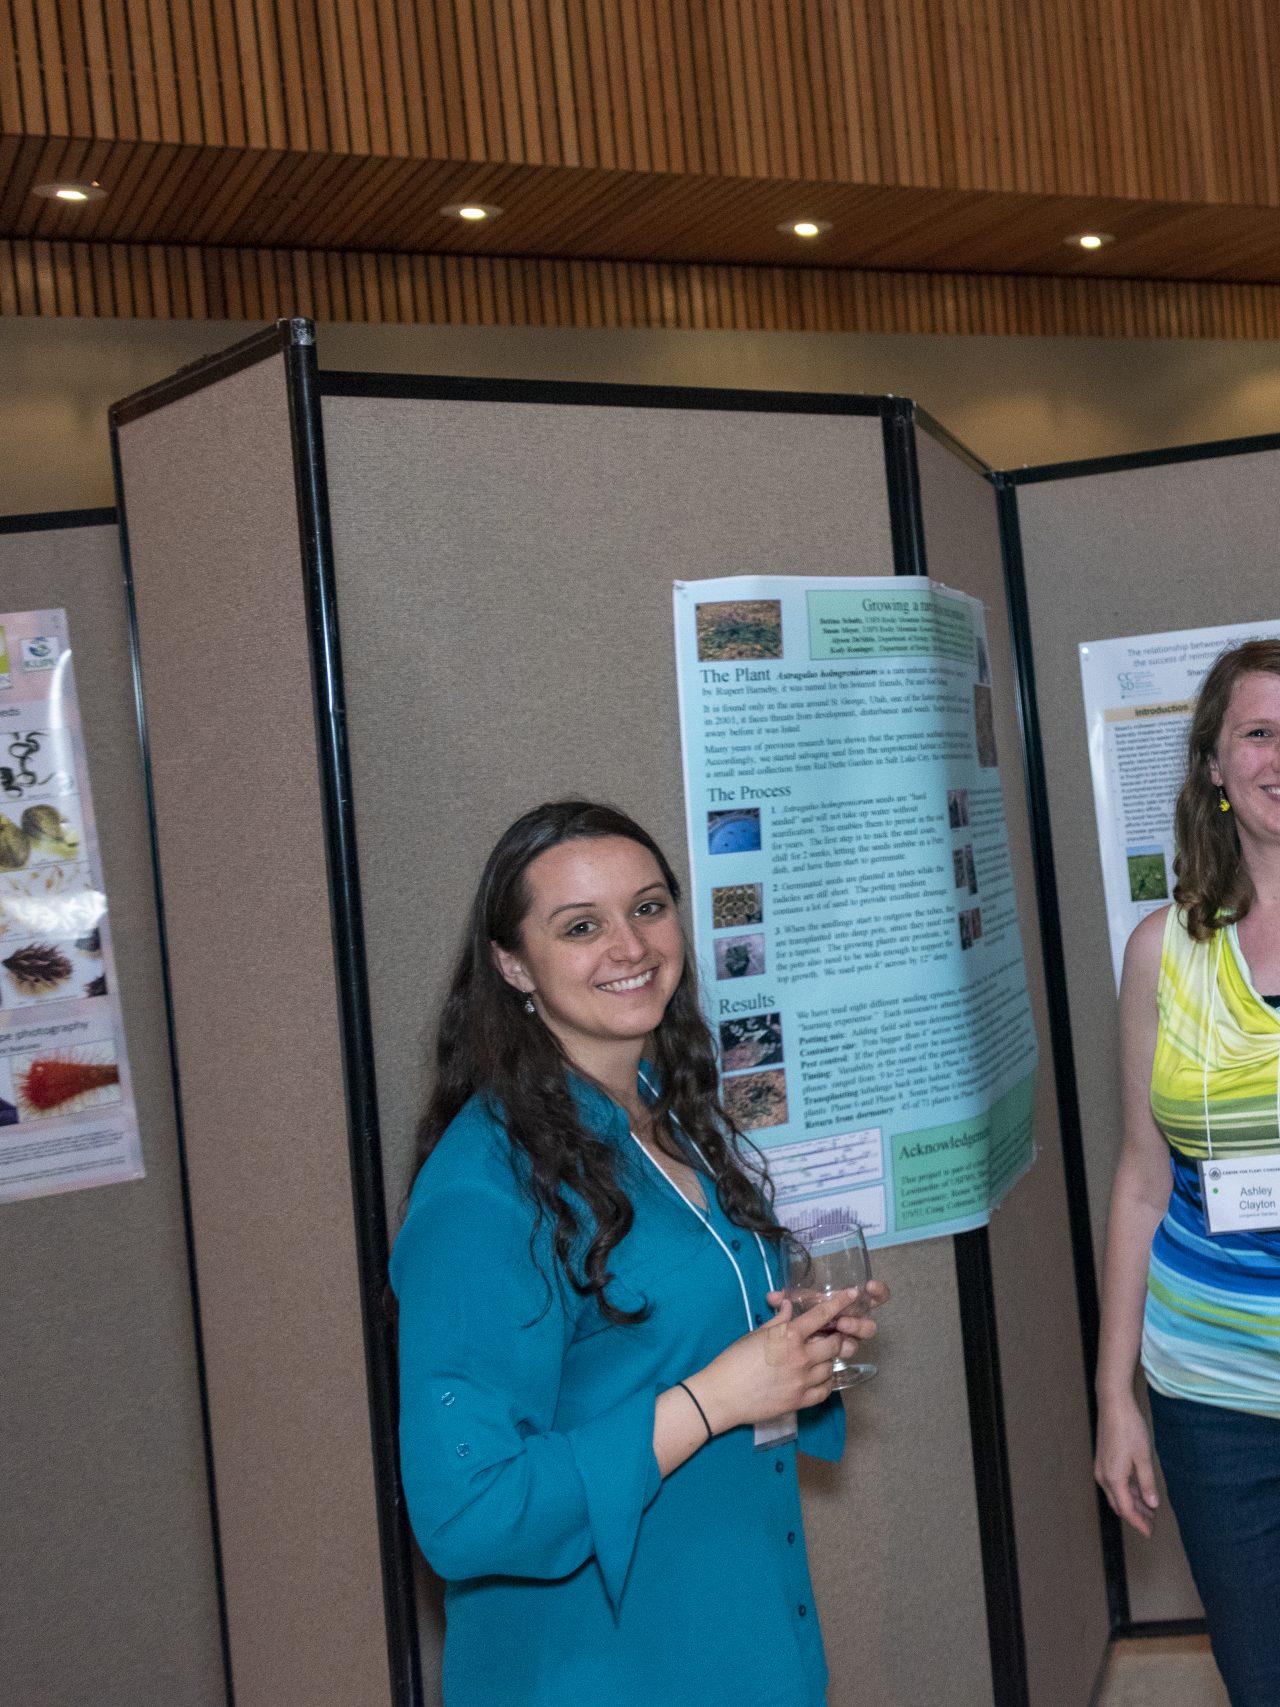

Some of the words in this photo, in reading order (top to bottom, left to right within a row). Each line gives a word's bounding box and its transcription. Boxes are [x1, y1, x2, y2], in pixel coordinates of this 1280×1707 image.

[862, 599, 909, 614] Growing
[1128, 648, 1141, 656] The
[1143, 643, 1188, 655] relationship
[1190, 640, 1225, 649] between
[1148, 655, 1178, 664] success
[700, 669, 729, 684] The
[735, 667, 771, 682] Plant
[722, 702, 745, 712] found
[1135, 704, 1188, 716] Introduction
[715, 715, 739, 724] 2001,
[705, 755, 757, 766] Accordingly,
[708, 787, 735, 802] The
[740, 785, 791, 800] Process
[719, 993, 775, 1014] Results
[1240, 1187, 1272, 1196] Ashley
[1240, 1200, 1276, 1210] Clayton
